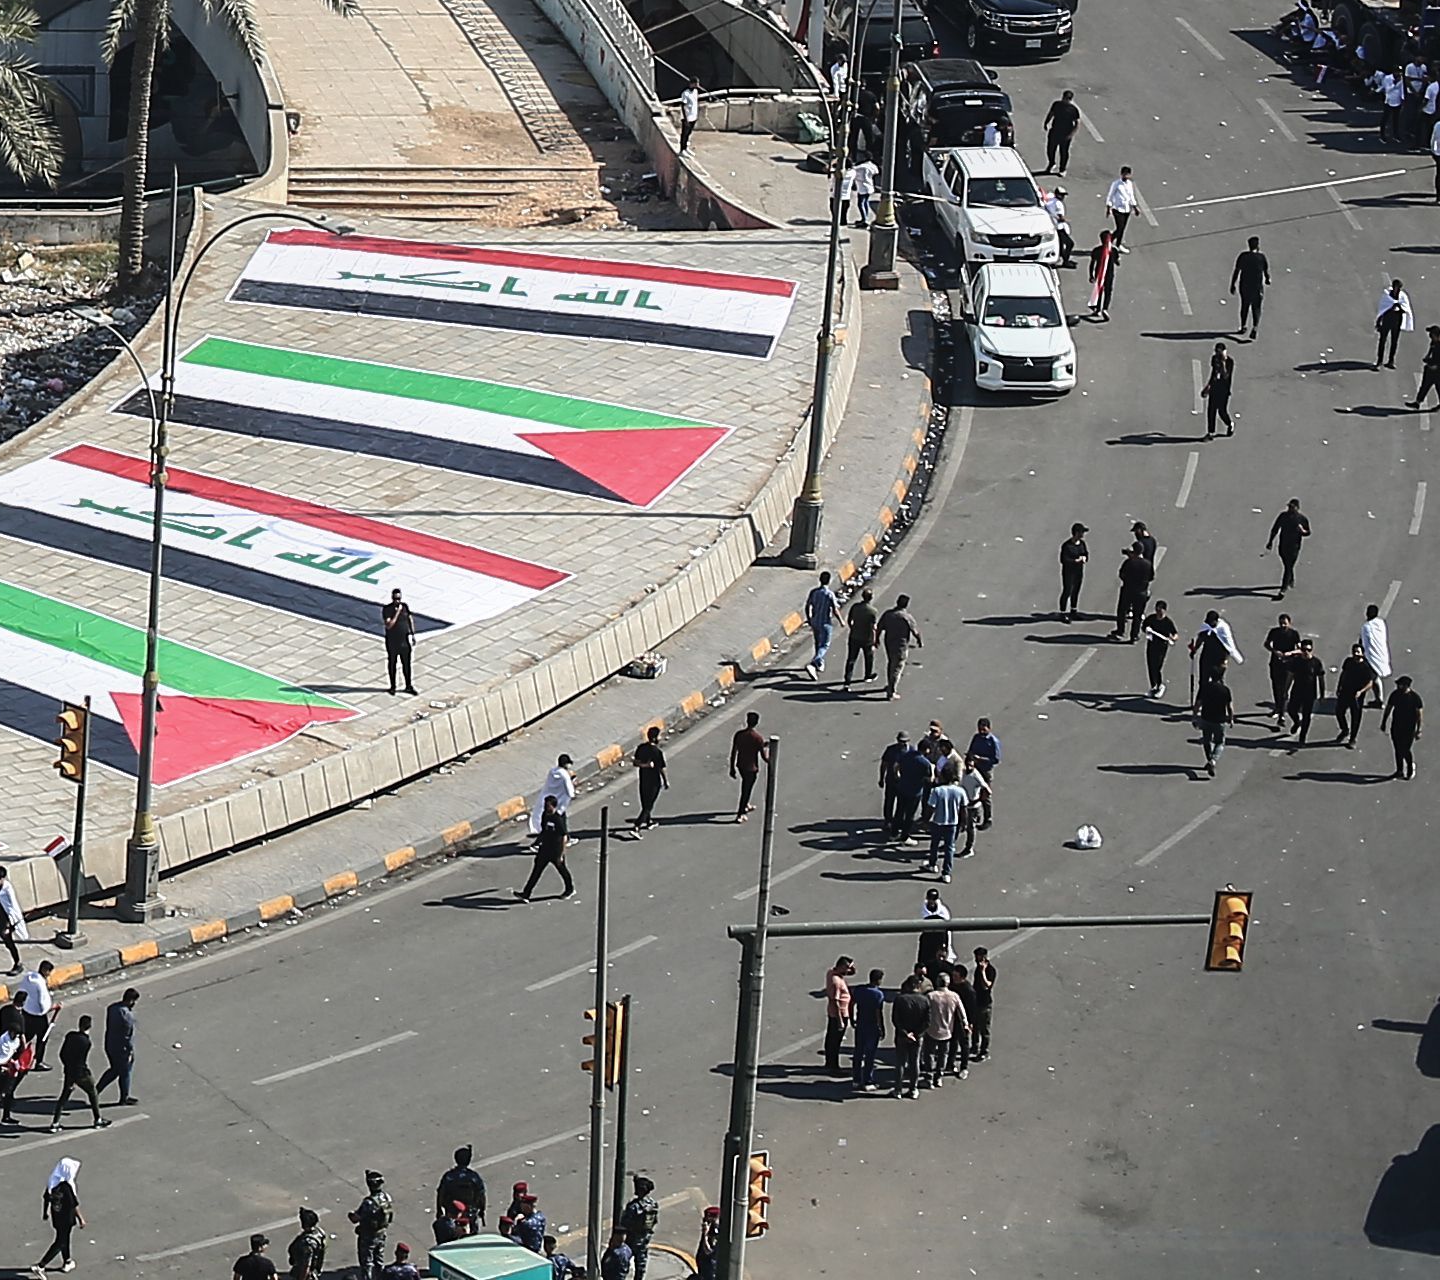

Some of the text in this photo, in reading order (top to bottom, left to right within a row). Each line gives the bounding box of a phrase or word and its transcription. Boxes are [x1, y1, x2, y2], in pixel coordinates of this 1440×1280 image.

[335, 270, 663, 311] الله اكبر
[272, 548, 392, 586] الله
